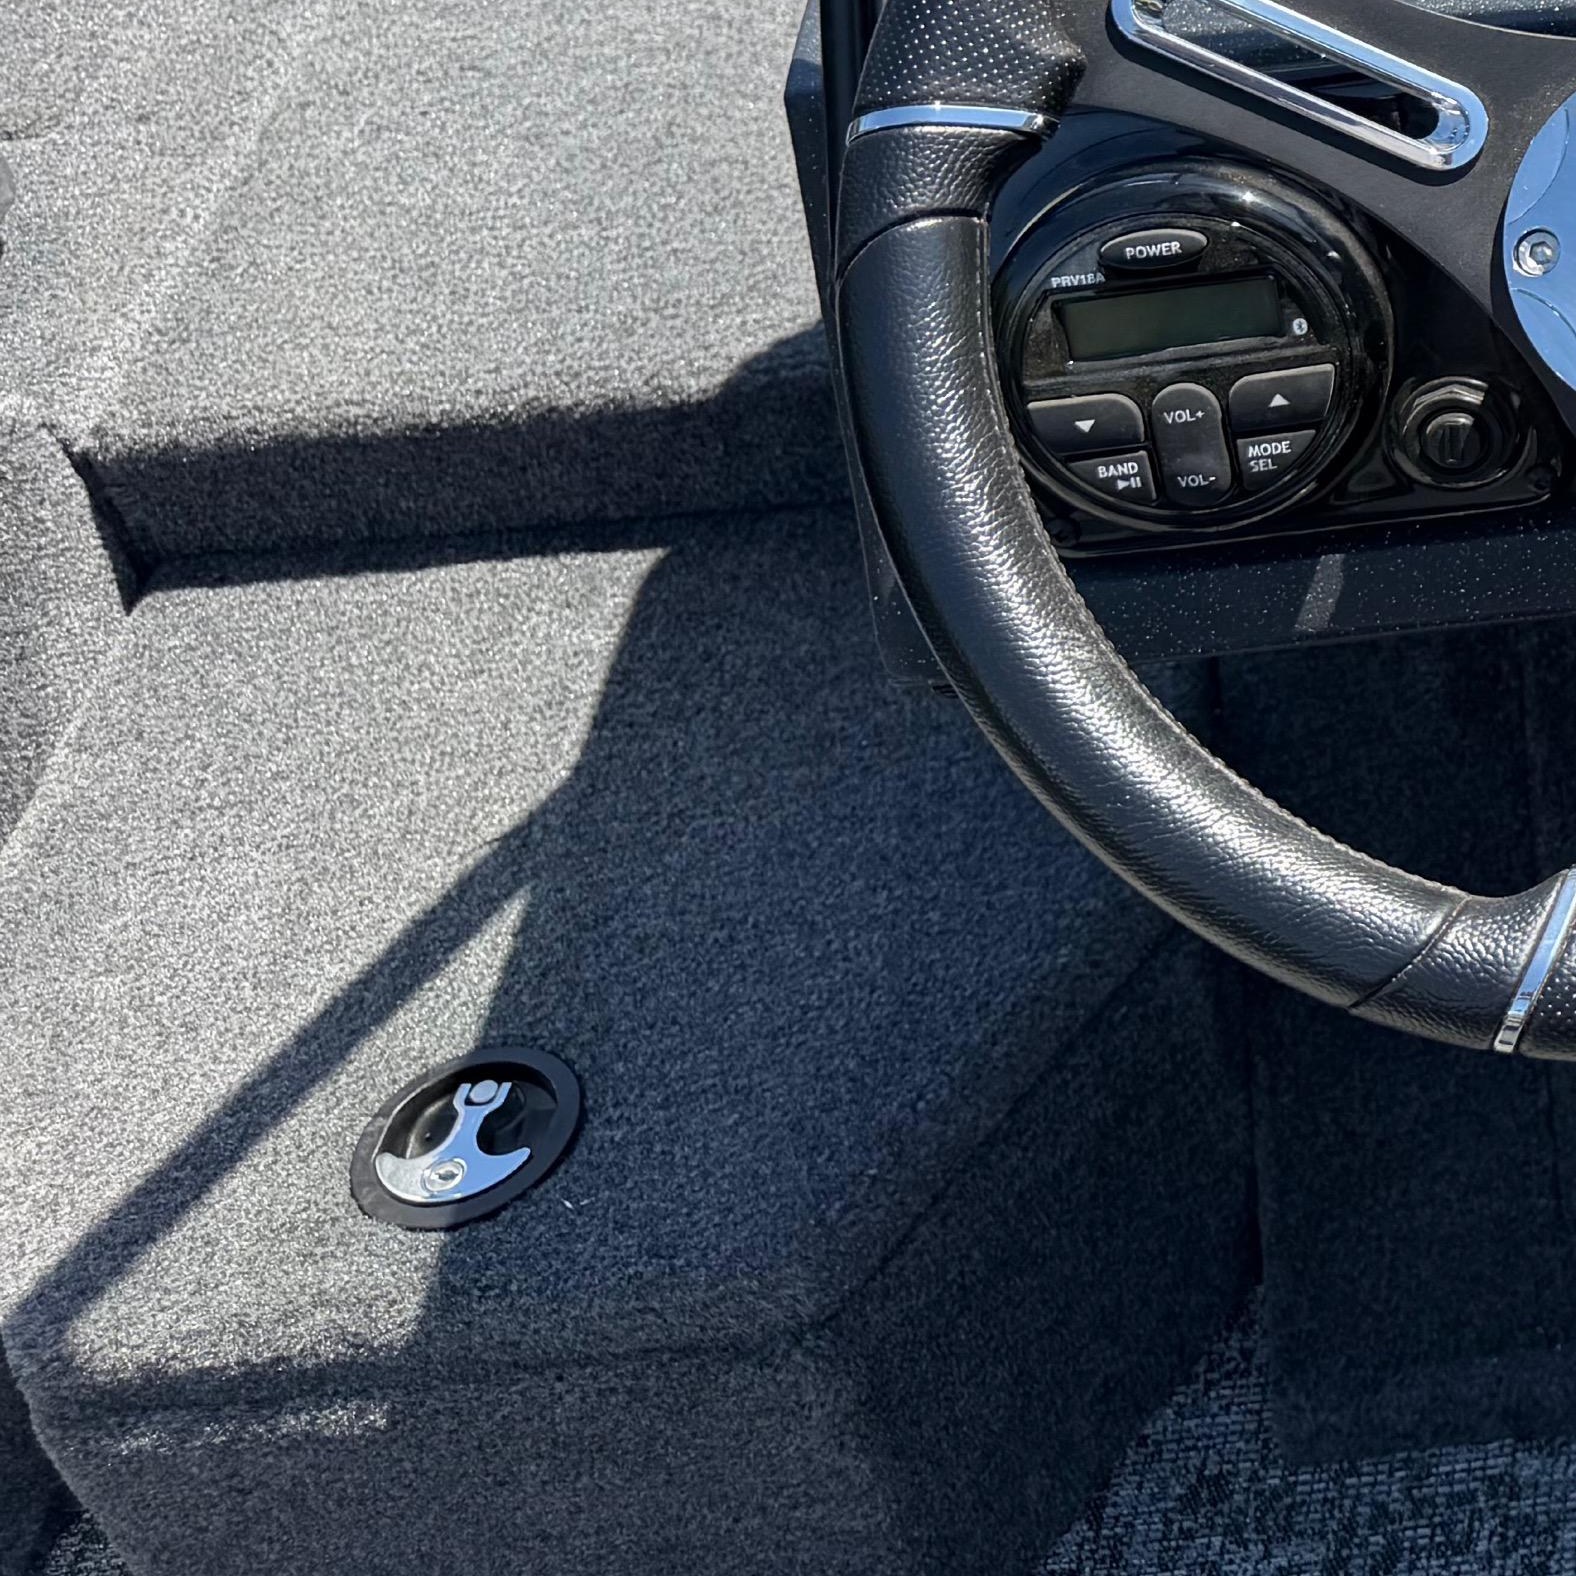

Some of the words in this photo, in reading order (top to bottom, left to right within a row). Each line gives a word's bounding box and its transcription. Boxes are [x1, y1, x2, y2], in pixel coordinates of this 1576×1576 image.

[1124, 241, 1183, 260] POWER
[1163, 408, 1206, 424] VOL+
[1247, 440, 1292, 458] MODE
[1097, 462, 1139, 479] BAND
[1249, 459, 1278, 473] SEL
[1178, 475, 1217, 488] VOL-
